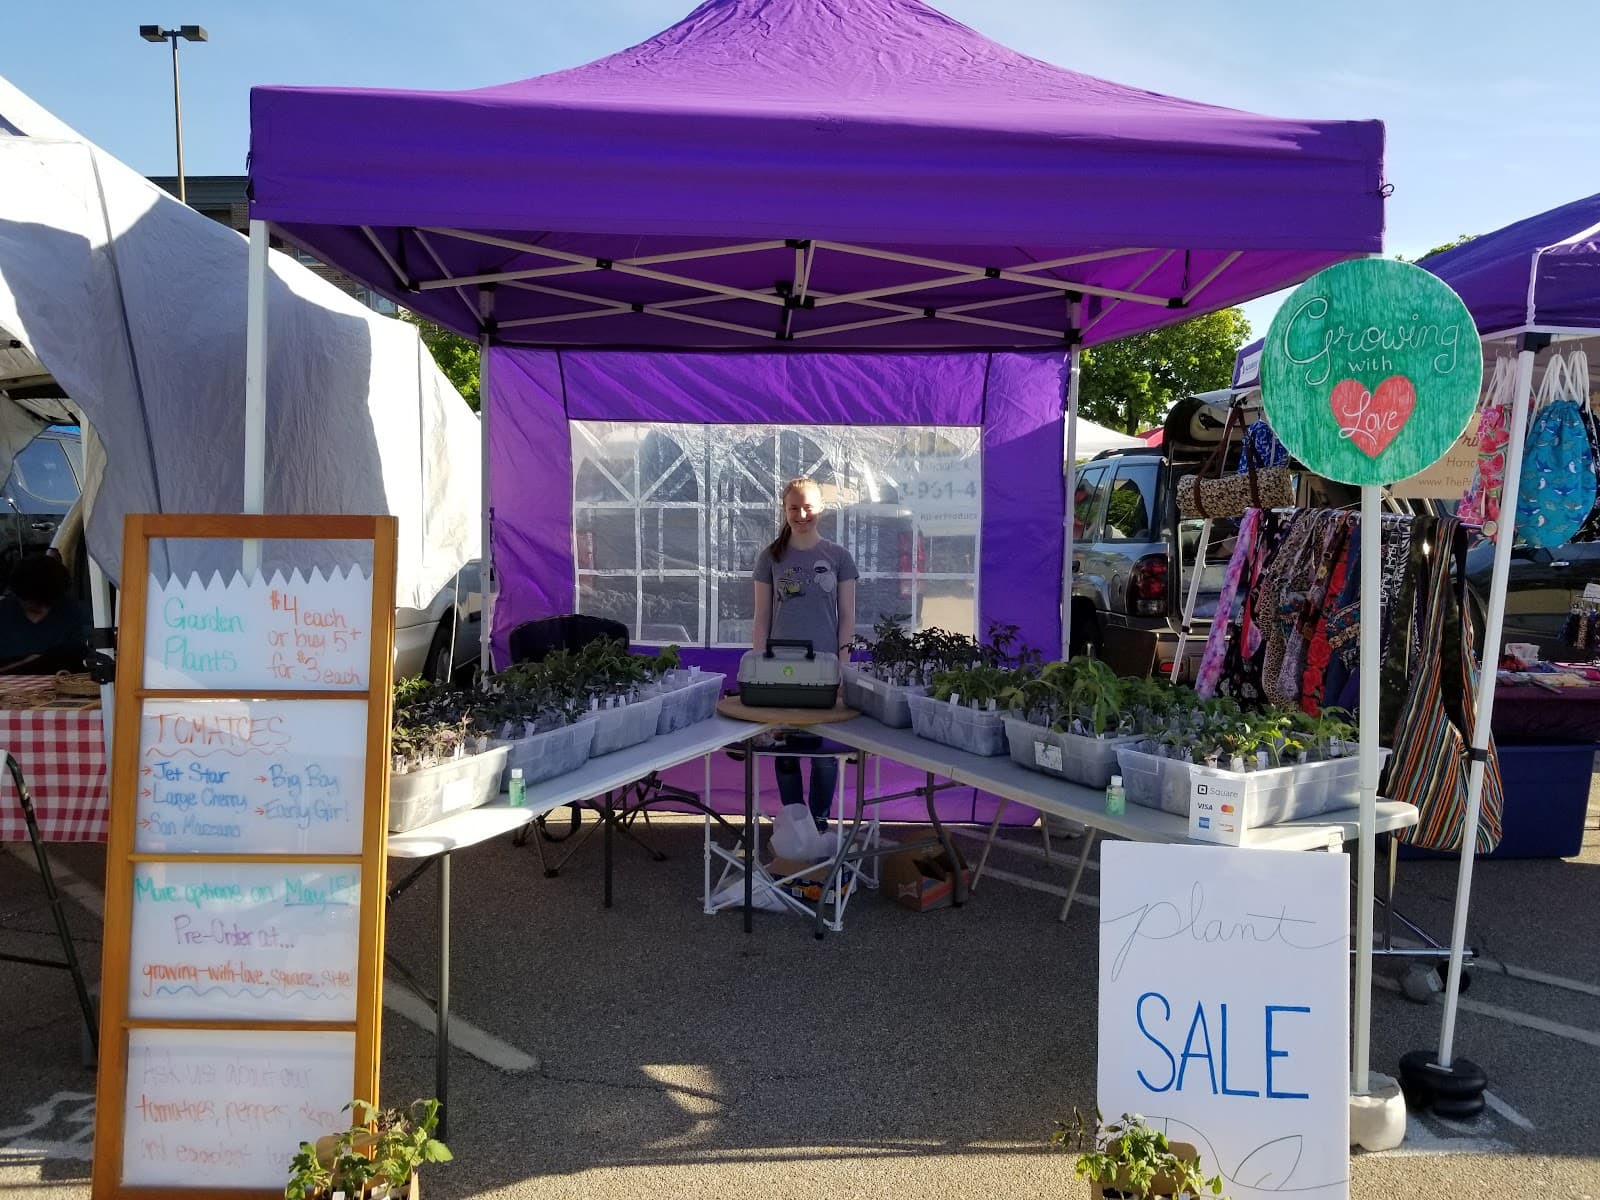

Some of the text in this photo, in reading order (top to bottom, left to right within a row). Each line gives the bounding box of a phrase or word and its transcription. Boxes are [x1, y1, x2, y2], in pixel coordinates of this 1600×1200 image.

[1284, 296, 1460, 386] Growing
[1349, 354, 1393, 373] with
[1338, 390, 1400, 446] Love
[163, 596, 246, 633] Garden
[303, 607, 346, 628] each
[163, 635, 239, 674] Plants
[267, 630, 289, 647] or
[294, 628, 326, 656] buy
[265, 651, 295, 680] for
[322, 667, 362, 686] each
[150, 713, 292, 746] TOMATOES
[153, 761, 231, 784] Jet Star
[269, 764, 302, 796] Big
[152, 781, 248, 815] Large Cherry
[1197, 801, 1214, 811] VISA
[1209, 786, 1240, 799] Square
[134, 876, 178, 904] More
[250, 884, 275, 904] on
[285, 877, 329, 912] May
[173, 913, 253, 947] Pre-Order
[1102, 879, 1342, 983] plant
[1136, 991, 1311, 1100] SALE
